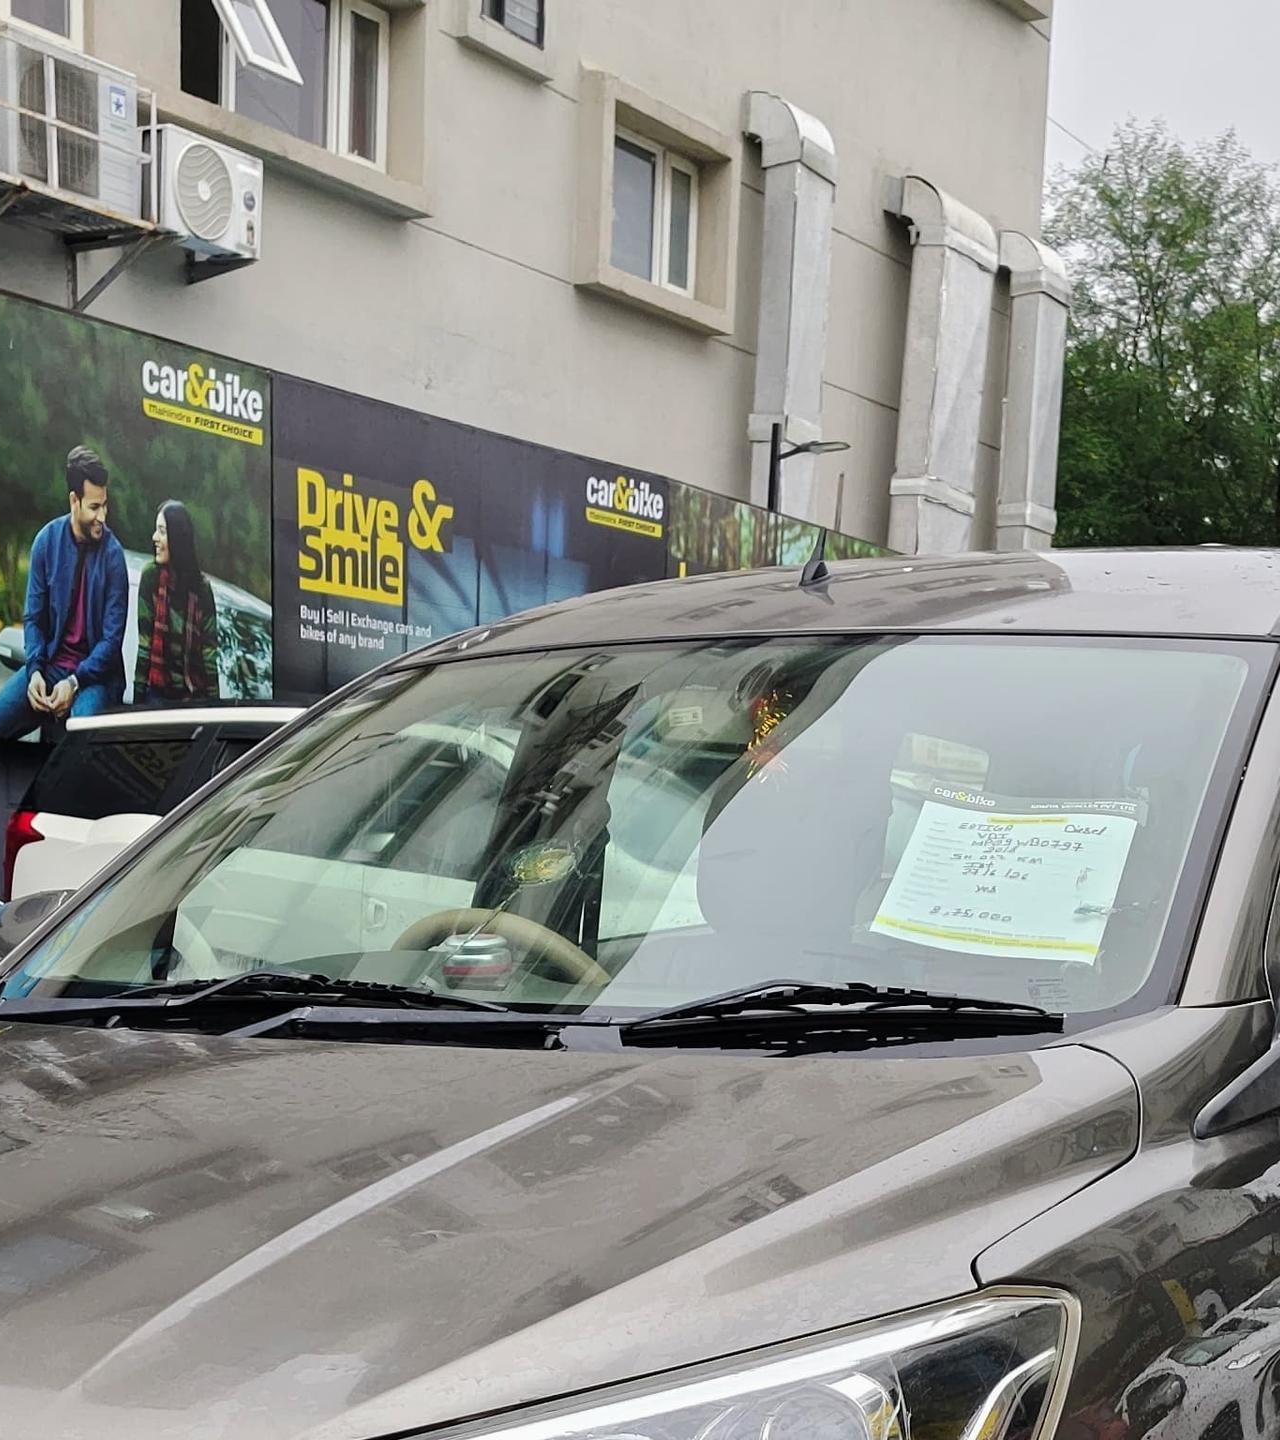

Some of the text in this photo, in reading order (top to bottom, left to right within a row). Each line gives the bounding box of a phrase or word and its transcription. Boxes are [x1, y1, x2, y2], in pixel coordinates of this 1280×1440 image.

[142, 360, 263, 422] car&bike
[194, 417, 221, 431] FIRST
[221, 424, 255, 439] CHOICE
[297, 467, 454, 553] Drive &
[586, 476, 664, 520] car&bike
[299, 524, 400, 594] Smile
[300, 604, 320, 625] Buy
[326, 608, 345, 625] Sell
[351, 612, 394, 635] Exchange
[395, 622, 414, 636] cars
[415, 625, 432, 638] and
[300, 623, 385, 650] bikes of any brand
